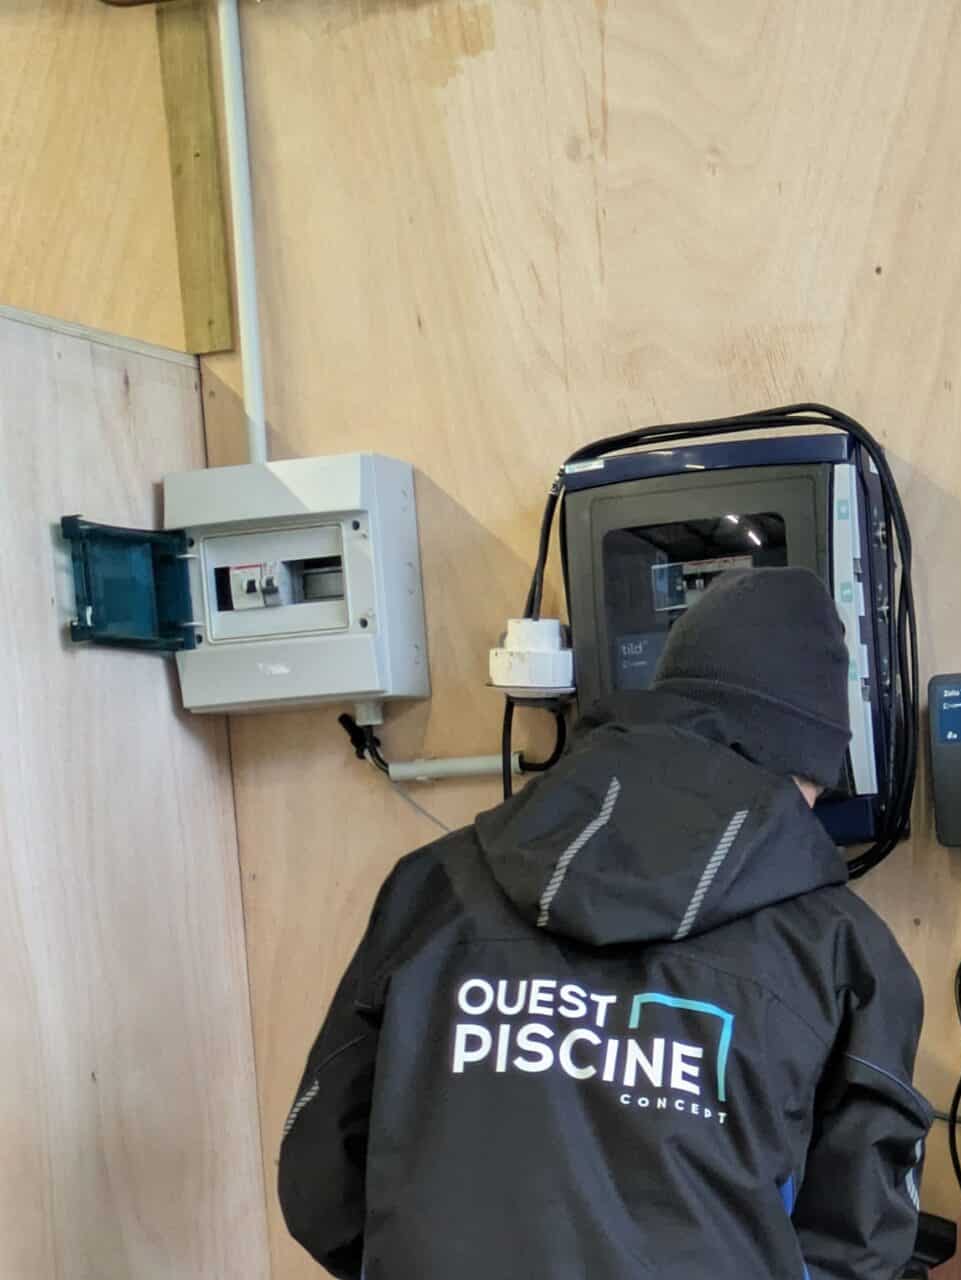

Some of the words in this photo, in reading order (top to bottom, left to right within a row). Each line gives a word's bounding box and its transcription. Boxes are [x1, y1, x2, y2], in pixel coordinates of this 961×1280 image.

[457, 978, 617, 1028] OUEST
[452, 1022, 704, 1096] PISCINE
[619, 1093, 728, 1125] CONCEPT
